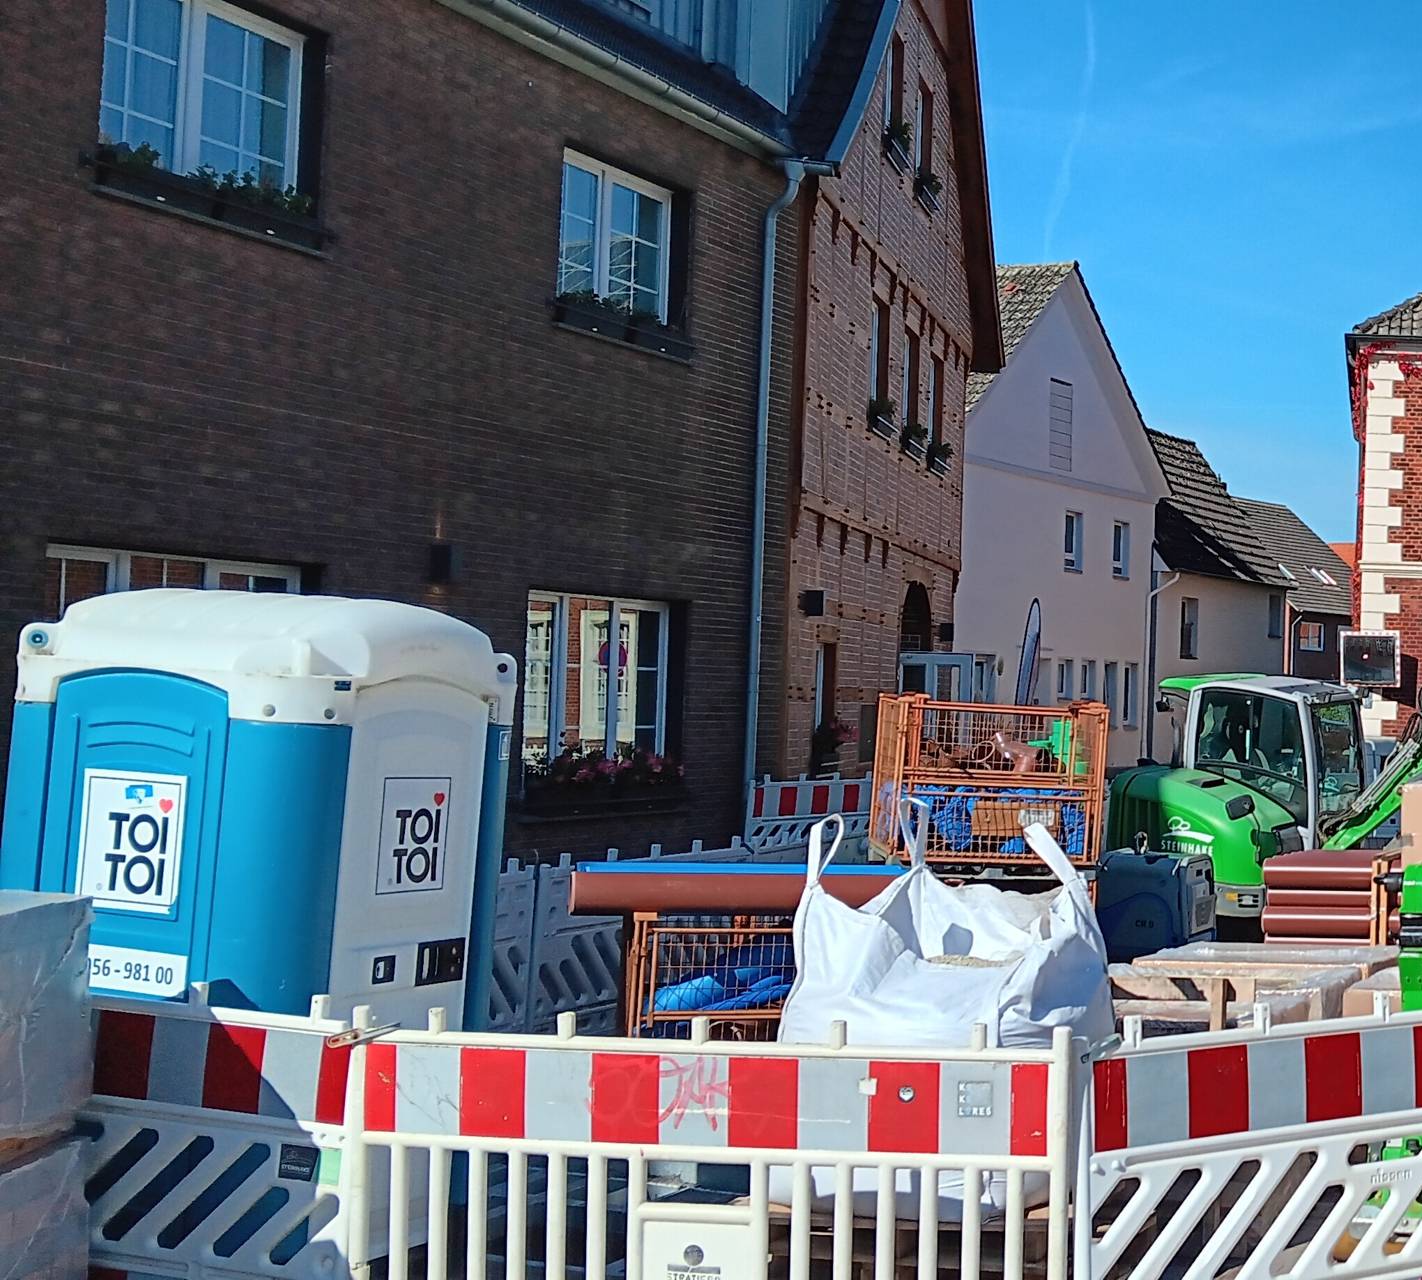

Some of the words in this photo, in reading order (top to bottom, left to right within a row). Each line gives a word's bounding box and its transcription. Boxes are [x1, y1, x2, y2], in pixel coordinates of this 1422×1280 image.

[109, 811, 169, 854] TOI
[396, 808, 441, 845] TOI
[393, 846, 438, 883] TOI
[1161, 840, 1213, 856] STEINHAKE
[105, 853, 165, 896] TOI
[123, 961, 151, 982] 981
[155, 966, 174, 985] 00
